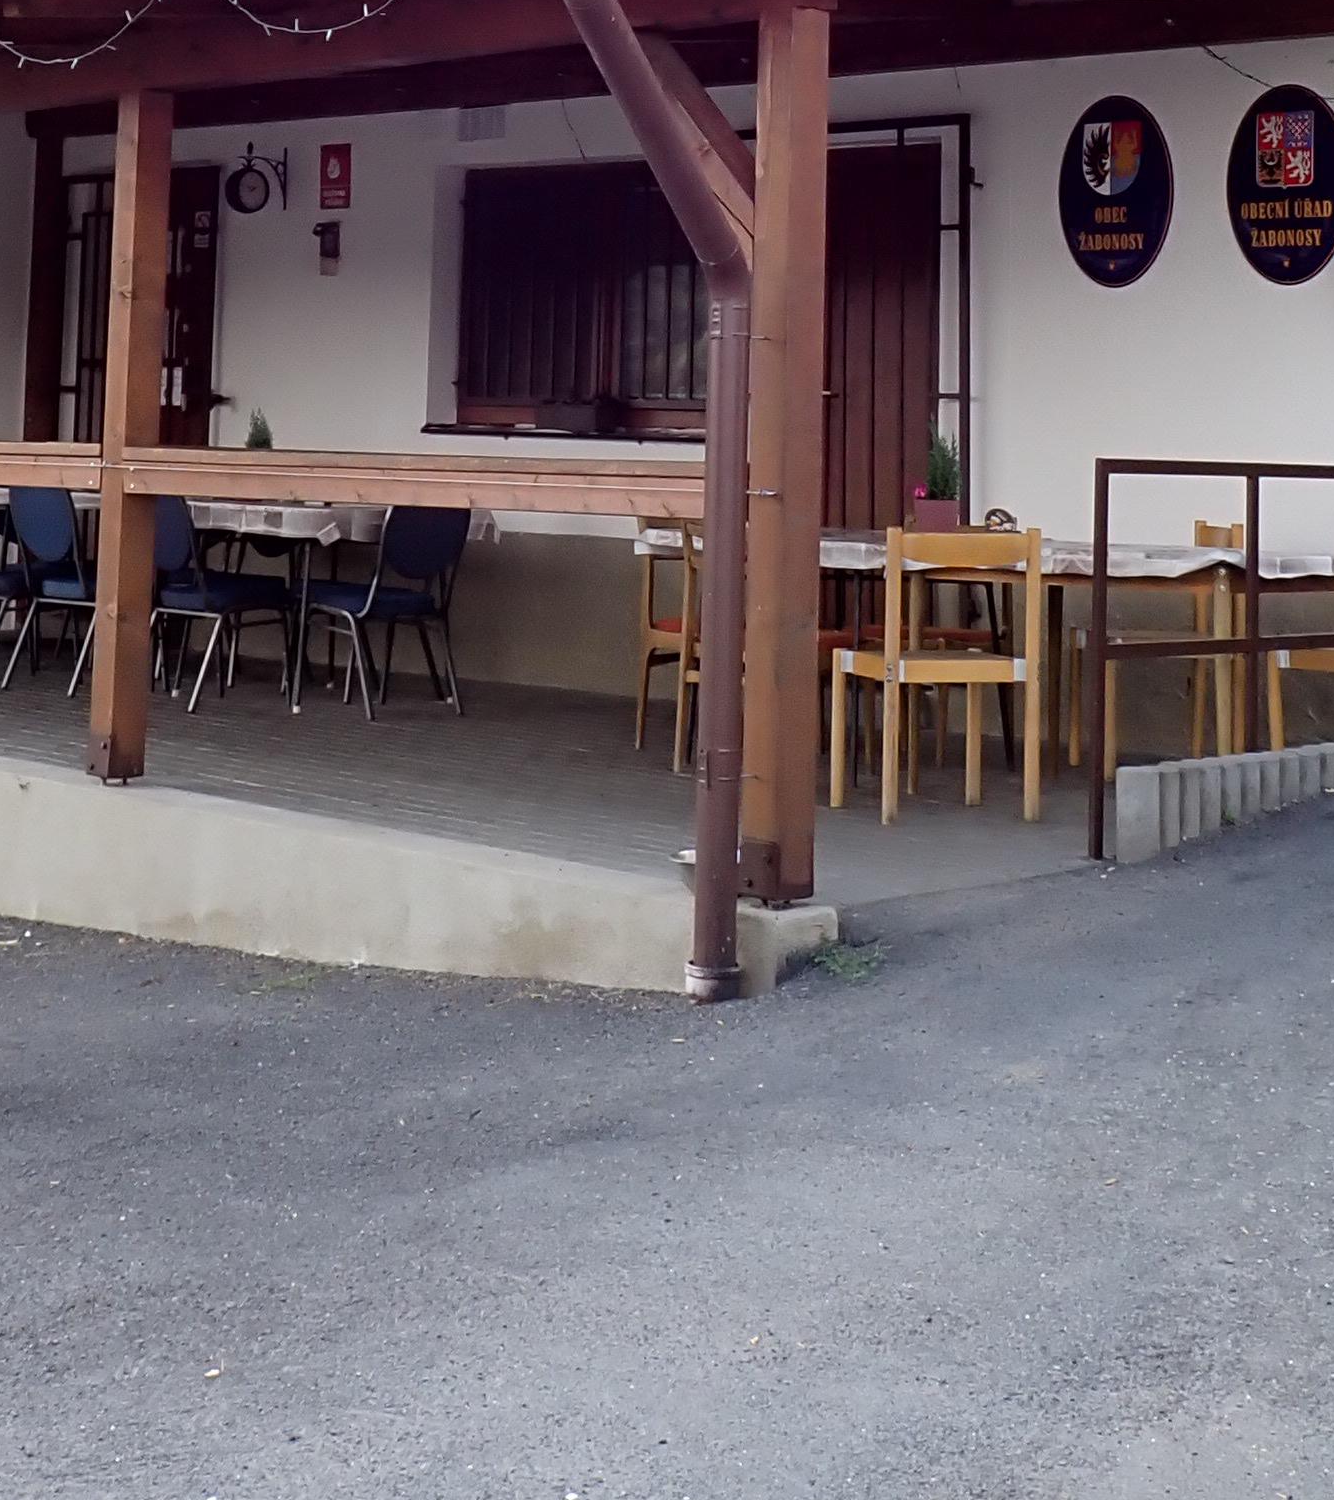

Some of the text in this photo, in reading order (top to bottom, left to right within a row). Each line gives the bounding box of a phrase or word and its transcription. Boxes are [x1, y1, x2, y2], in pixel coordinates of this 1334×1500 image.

[1094, 206, 1128, 224] OBEC
[1240, 197, 1332, 219] OBECNÍ ÚŘAD
[1078, 231, 1145, 251] ŽABONOSY
[1250, 227, 1323, 248] ŽABONOSY
